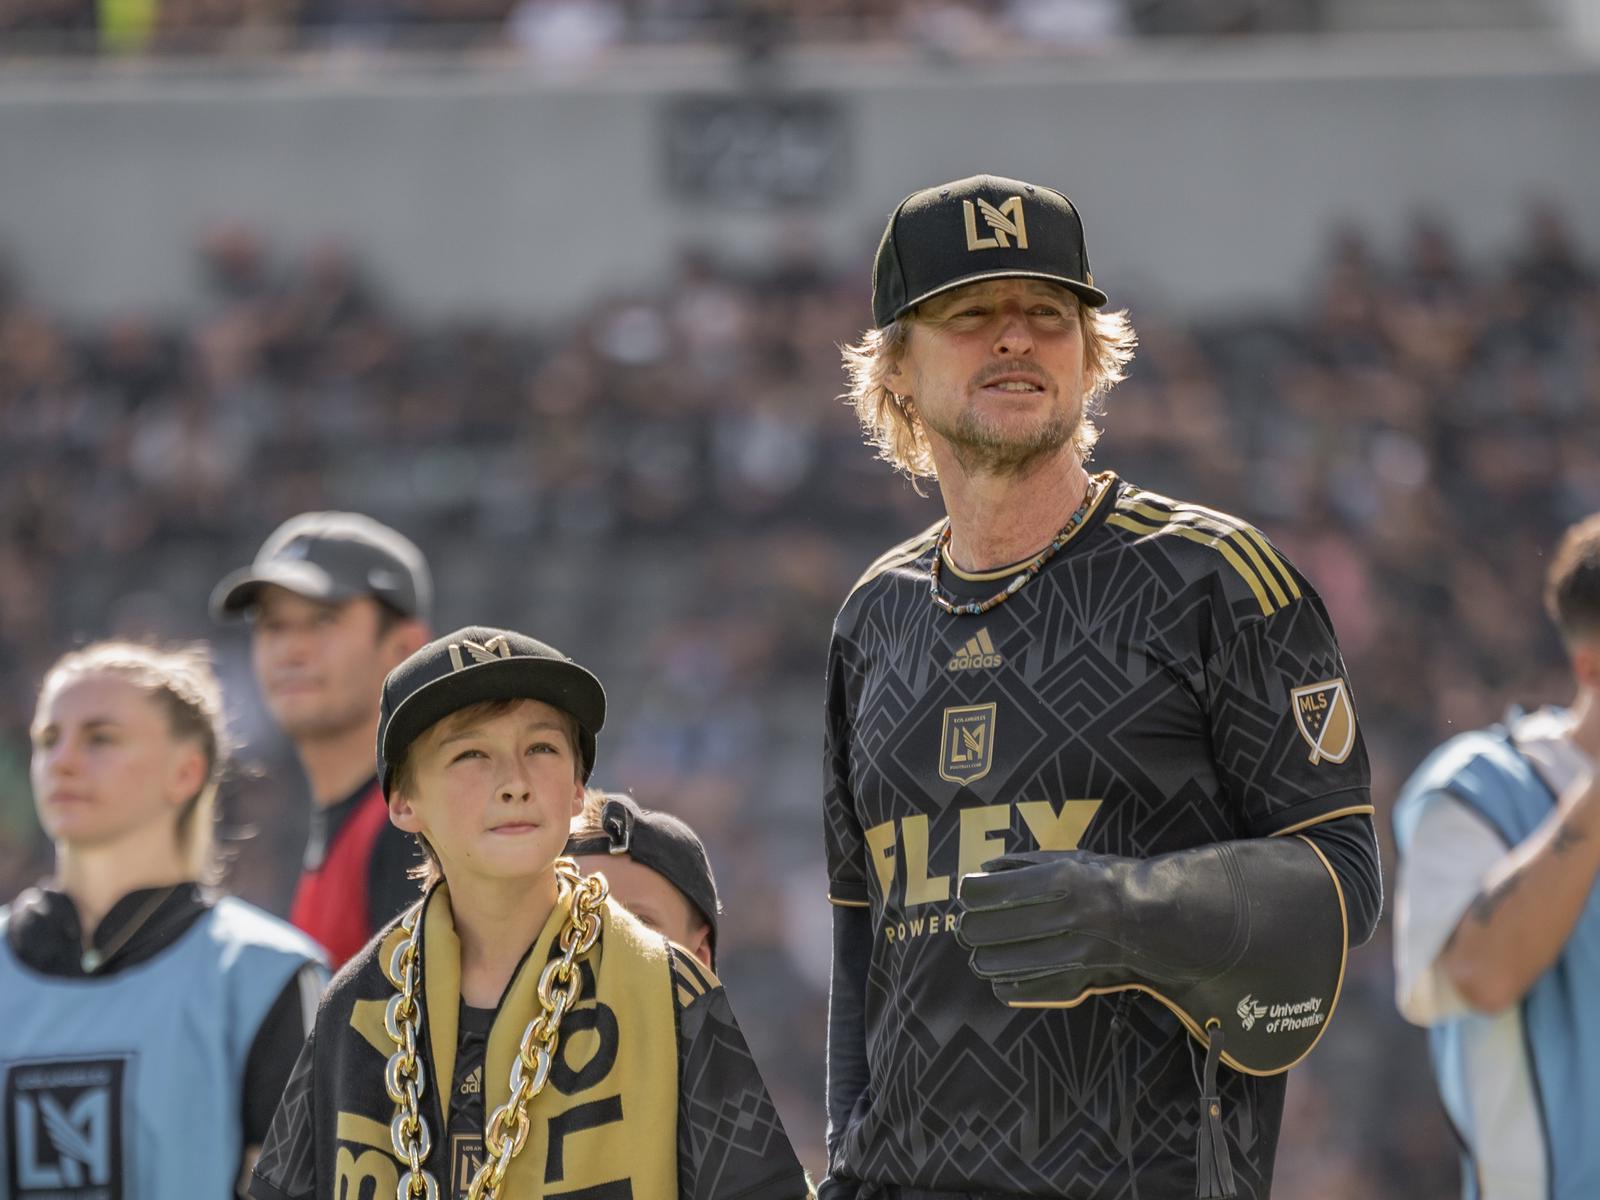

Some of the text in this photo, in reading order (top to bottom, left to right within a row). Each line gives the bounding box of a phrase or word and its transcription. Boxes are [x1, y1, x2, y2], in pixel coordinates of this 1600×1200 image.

[948, 654, 1002, 672] adidas
[1299, 692, 1328, 713] MLS
[885, 913, 957, 944] POWER
[1269, 997, 1322, 1018] University
[1266, 1019, 1280, 1033] of
